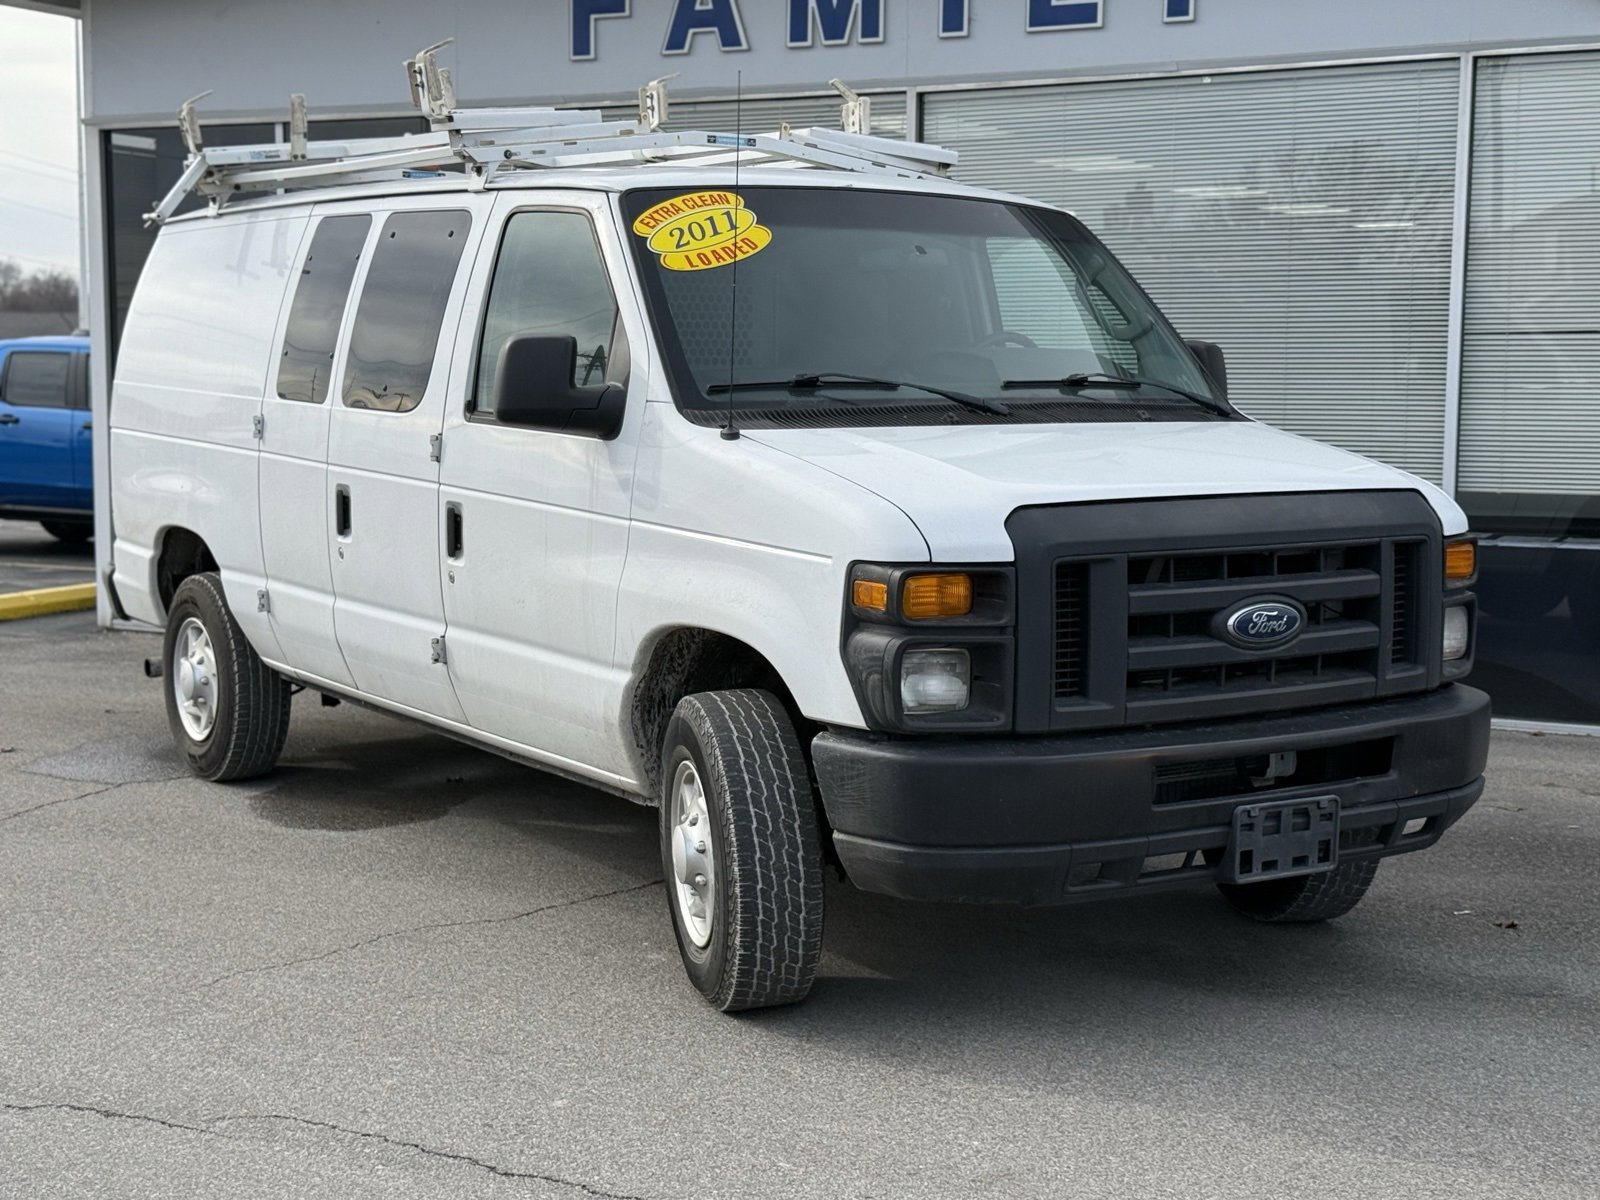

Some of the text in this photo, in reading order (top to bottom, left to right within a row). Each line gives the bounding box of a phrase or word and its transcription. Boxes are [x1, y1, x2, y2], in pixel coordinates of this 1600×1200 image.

[638, 193, 731, 230] EXTRA CLEAN
[669, 210, 740, 250] 2011
[684, 237, 759, 269] LOADED
[1248, 611, 1288, 635] Ford
